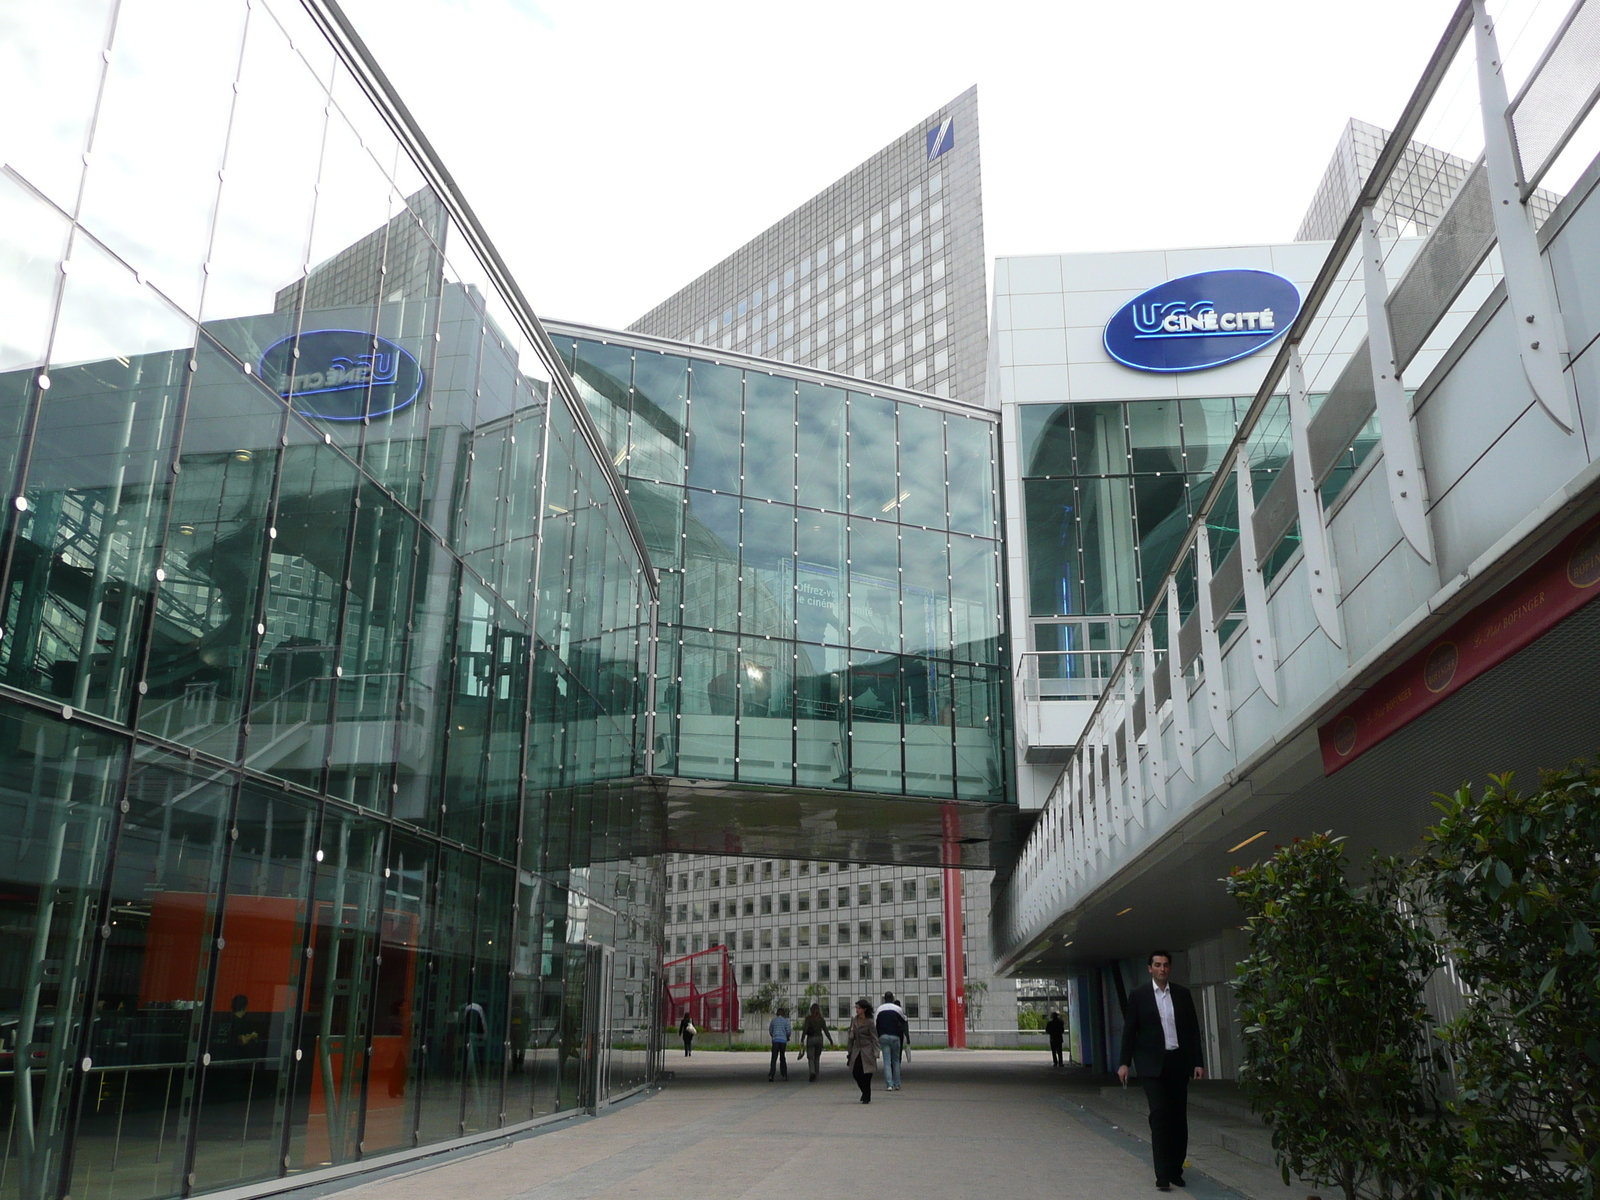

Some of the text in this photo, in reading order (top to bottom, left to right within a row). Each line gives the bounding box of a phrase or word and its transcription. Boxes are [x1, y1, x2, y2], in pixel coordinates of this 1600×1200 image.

[1163, 308, 1275, 332] CINÉ CITÉ
[797, 582, 839, 599] Offrez-vo
[1503, 591, 1545, 629] BOFINGER
